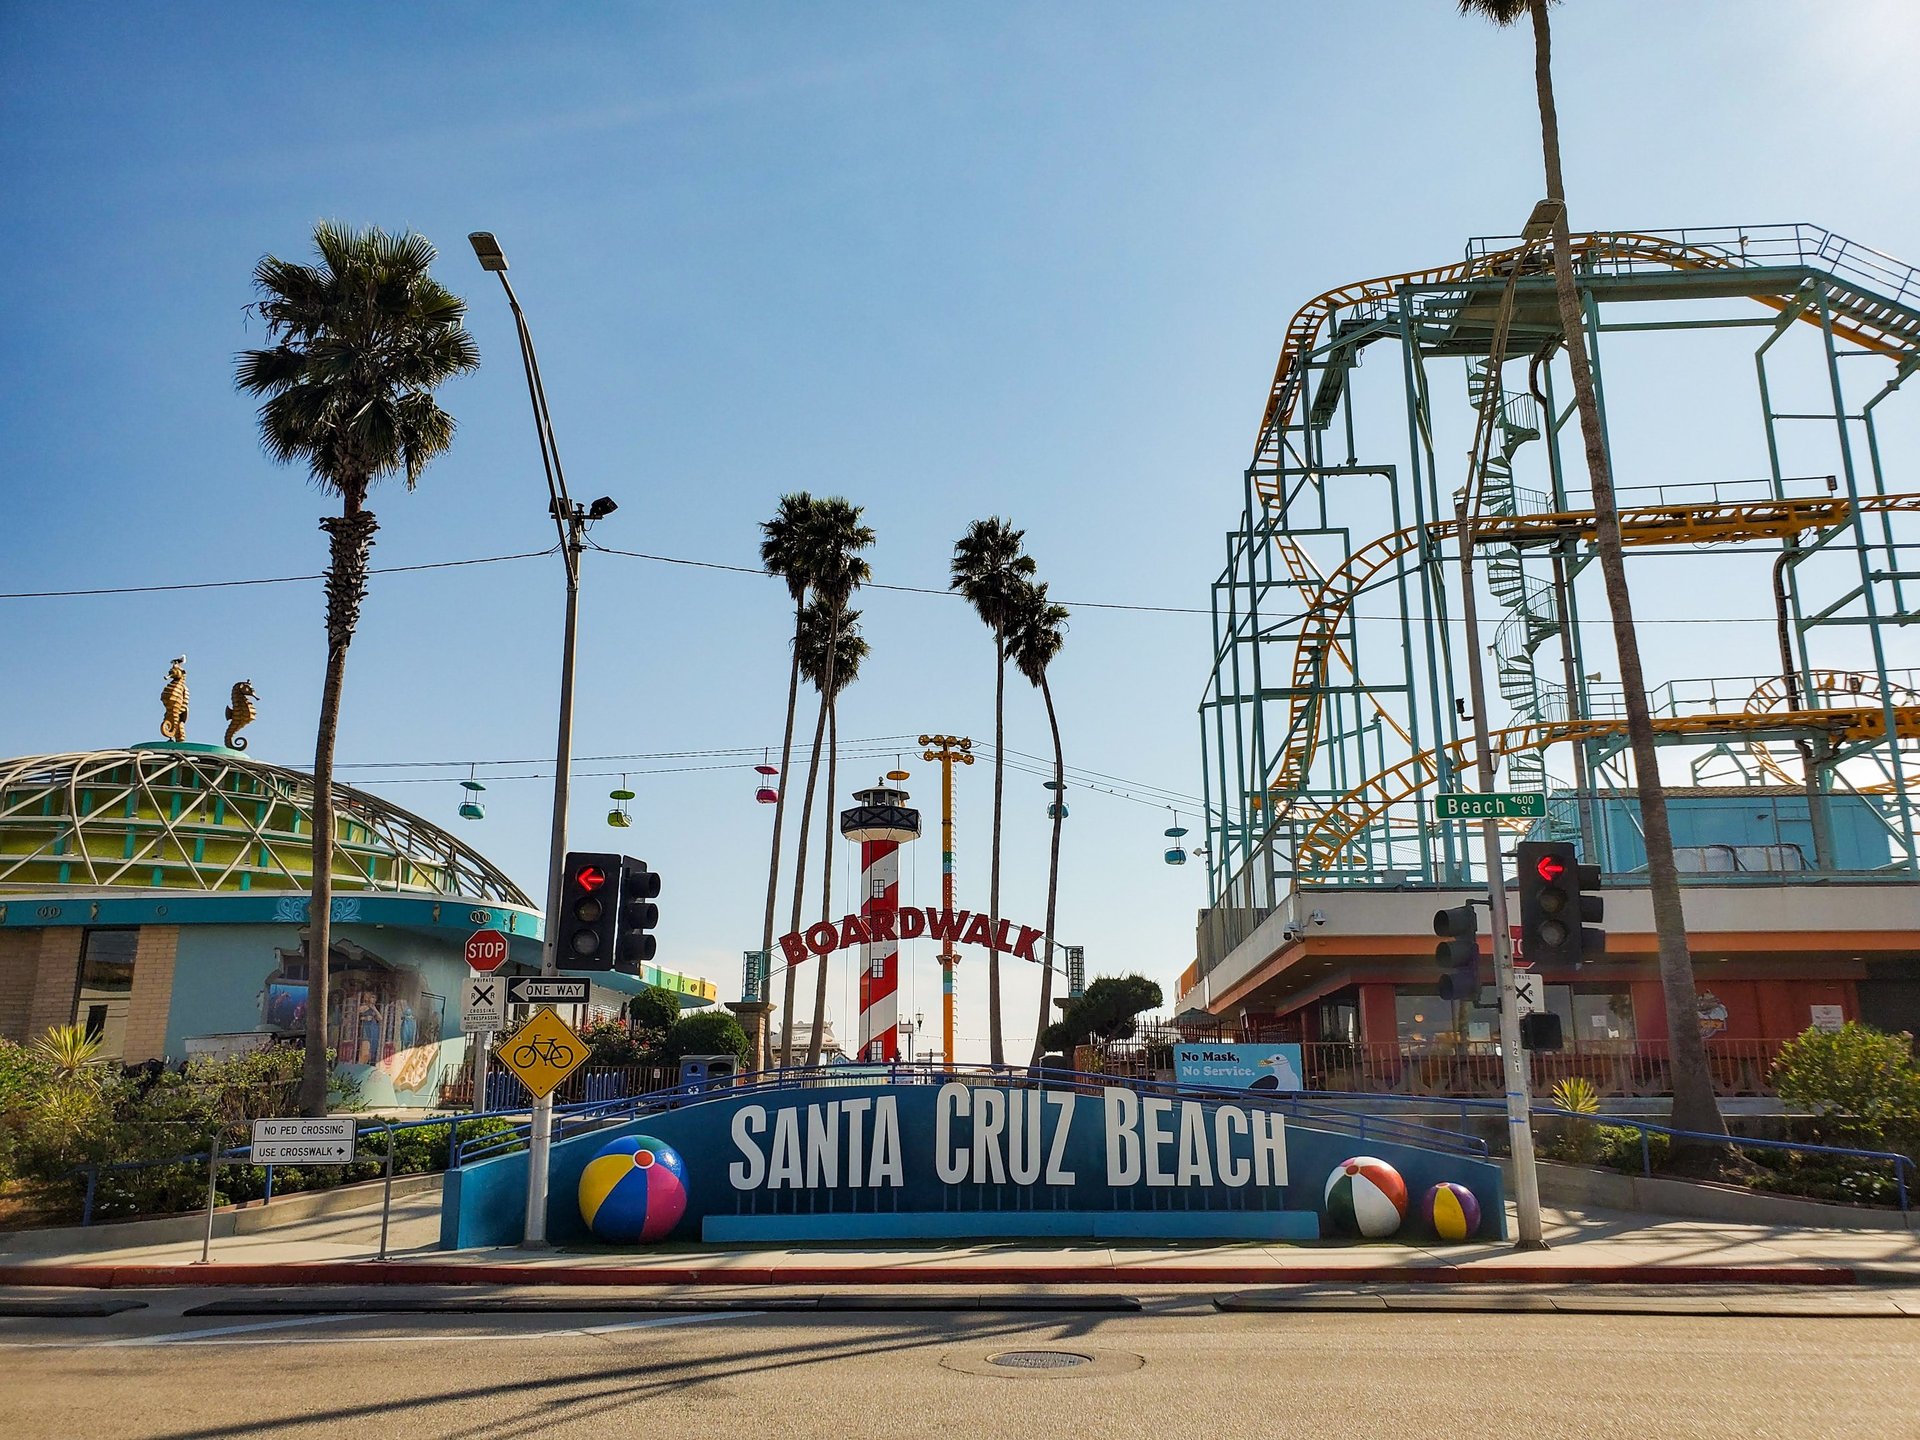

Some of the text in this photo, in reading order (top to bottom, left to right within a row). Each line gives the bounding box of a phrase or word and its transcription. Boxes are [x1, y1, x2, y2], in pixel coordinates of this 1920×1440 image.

[1517, 795, 1534, 805] 600
[1447, 798, 1532, 815] Beach St
[778, 906, 1045, 967] BOARDWALK
[468, 942, 504, 959] STOP
[470, 991, 496, 1000] R R
[526, 985, 582, 996] ONE WAY
[1181, 1051, 1240, 1063] No Mask,
[1182, 1066, 1255, 1076] No Service.
[264, 1125, 344, 1135] NO PED CROSSING
[728, 1082, 1290, 1190] SANTA CRUZ BEACH
[259, 1147, 333, 1157] USE CROSSWALK
